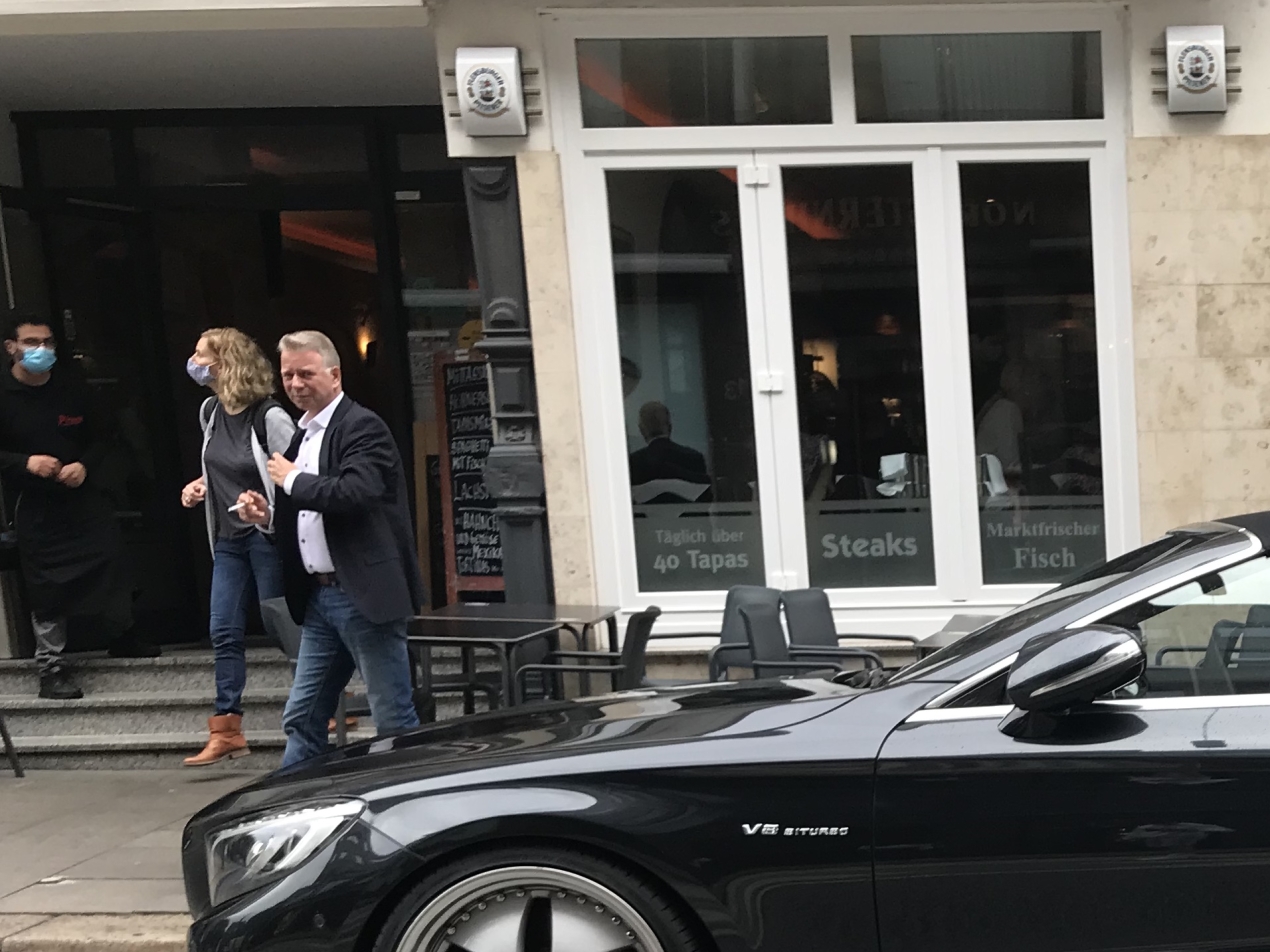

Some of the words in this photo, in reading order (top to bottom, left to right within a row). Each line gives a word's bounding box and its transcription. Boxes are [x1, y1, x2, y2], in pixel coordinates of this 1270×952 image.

[655, 528, 706, 546] Täglich
[711, 527, 744, 543] über
[986, 521, 1101, 538] Marktfrischer
[820, 532, 918, 558] Steaks
[653, 554, 680, 573] 40
[687, 550, 749, 573] Tapas
[1012, 547, 1077, 569] Fisch
[741, 823, 779, 836] V8
[783, 826, 849, 836] BITURBO
